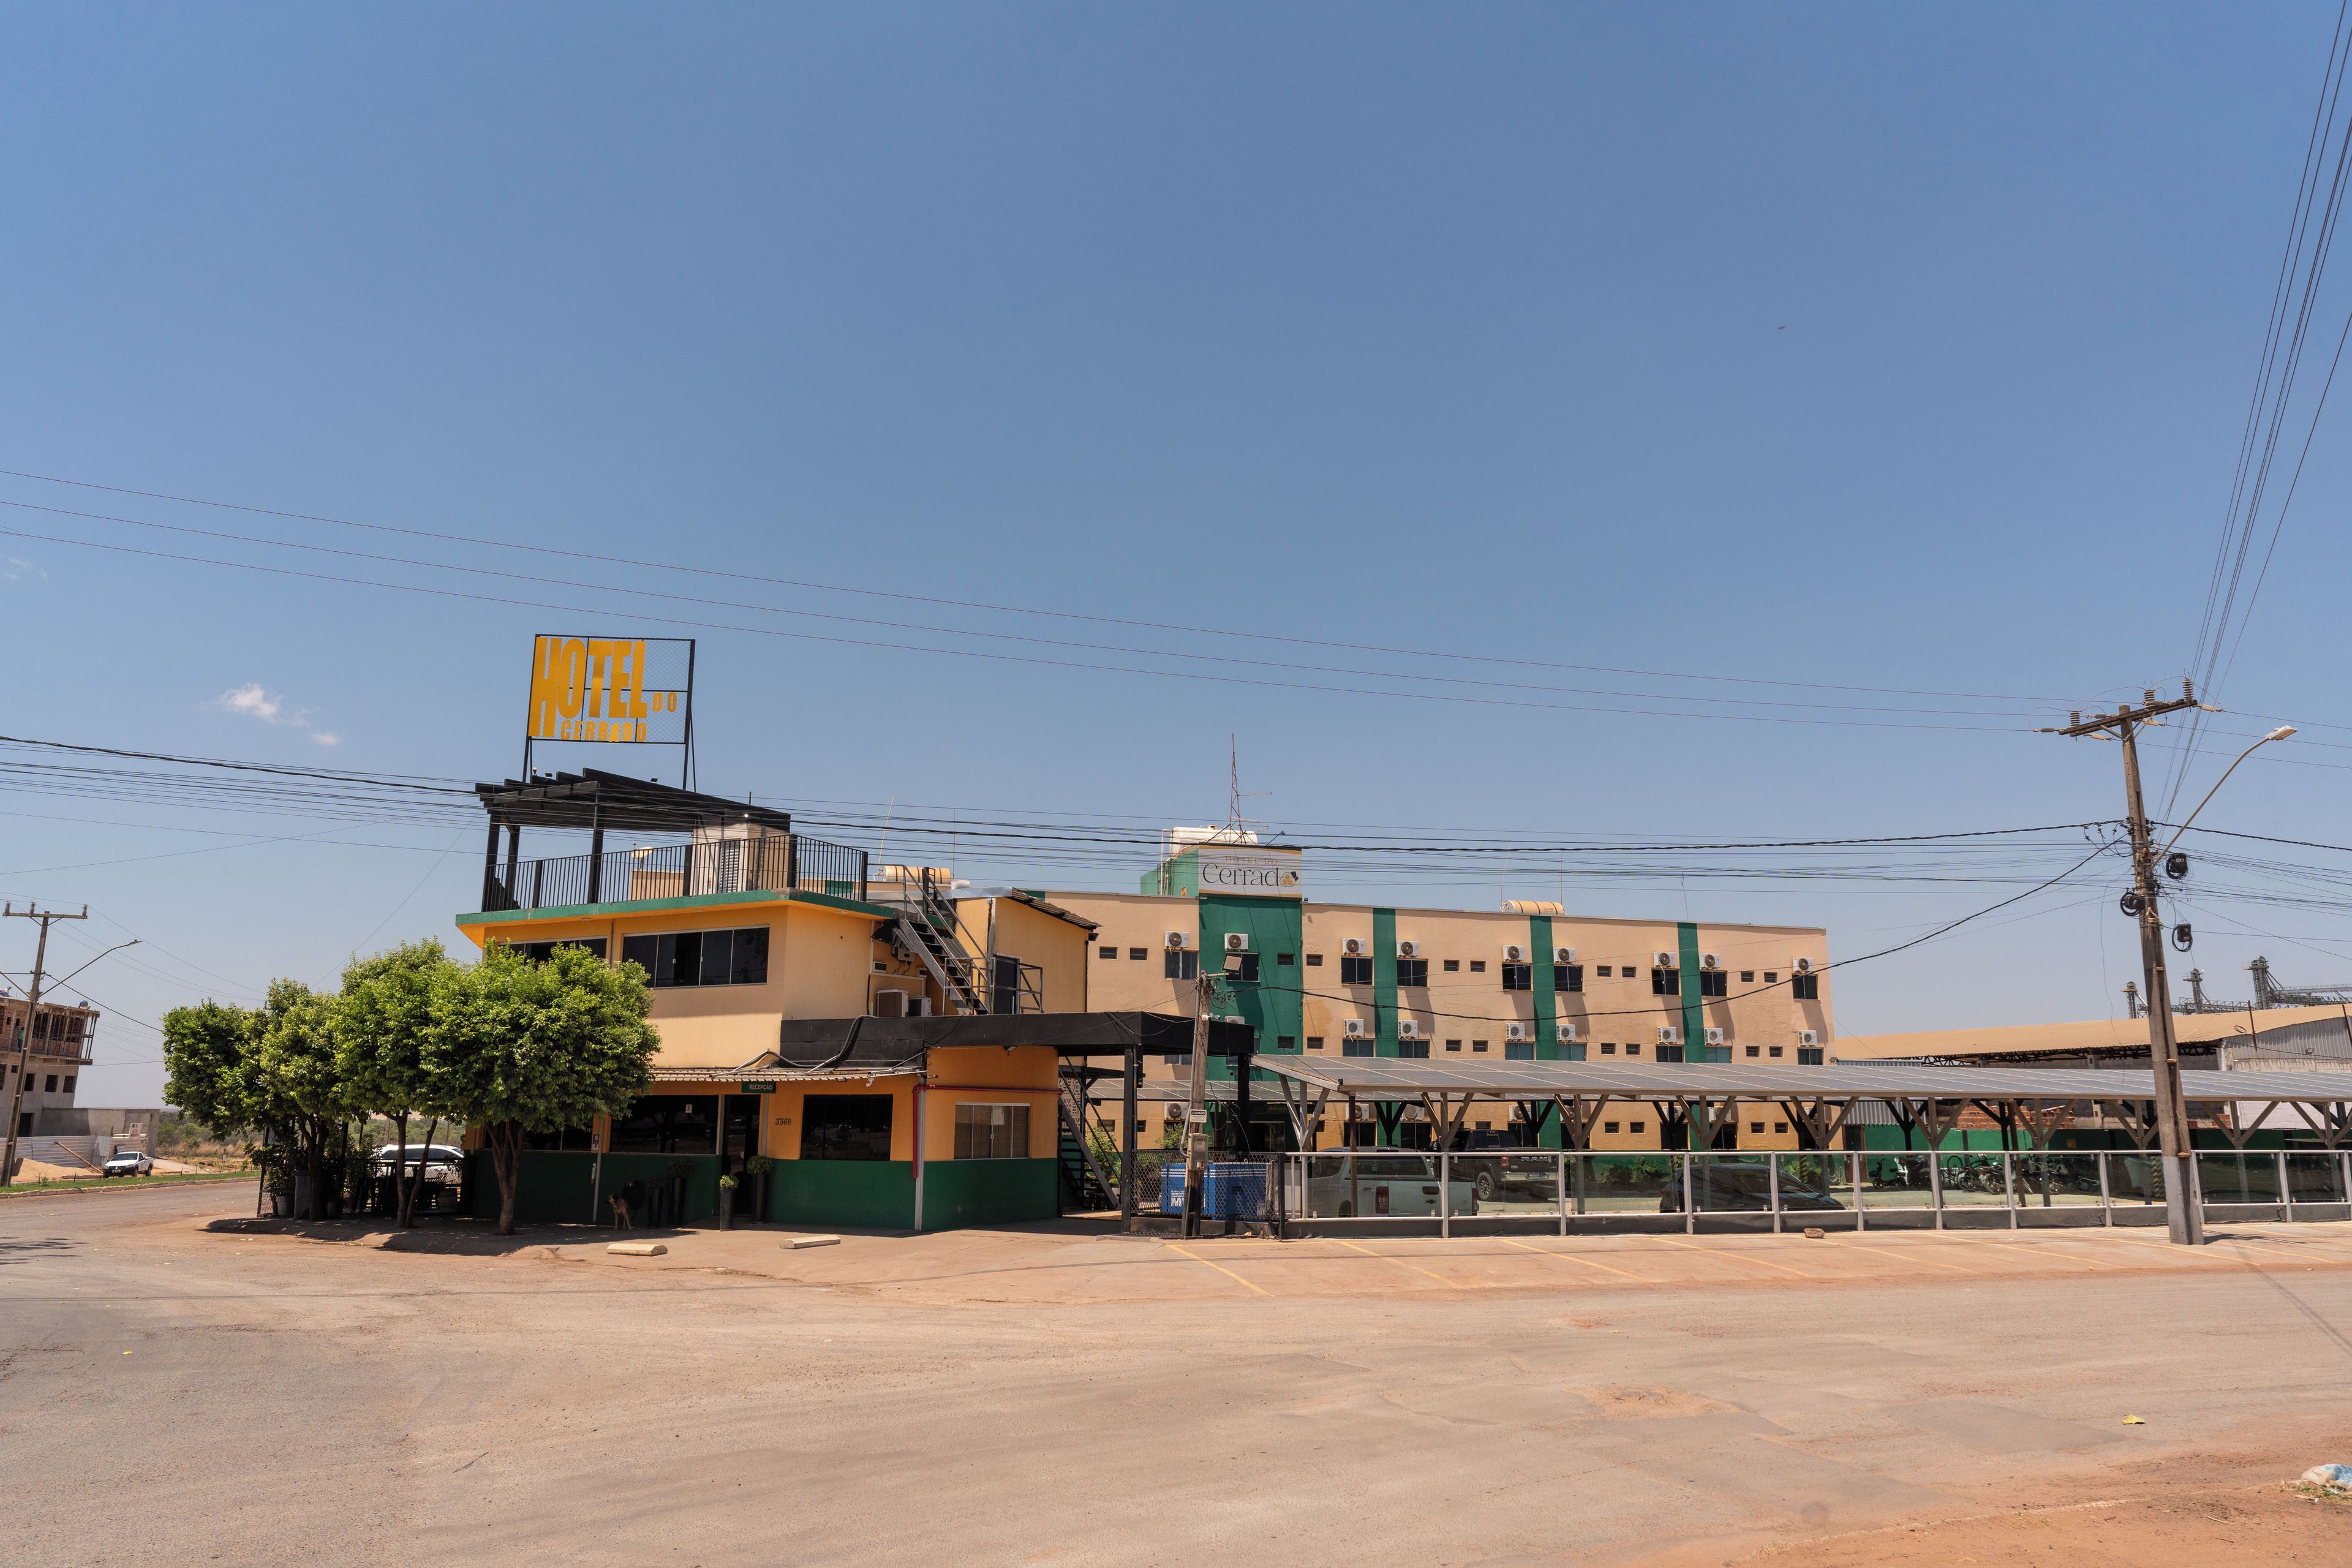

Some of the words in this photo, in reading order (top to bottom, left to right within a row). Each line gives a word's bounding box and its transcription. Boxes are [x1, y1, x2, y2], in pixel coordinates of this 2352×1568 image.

[528, 637, 647, 737] HOTEL
[652, 692, 677, 712] DO
[560, 720, 647, 743] CERRADO
[1225, 856, 1259, 864] HOTEL
[775, 1117, 792, 1126] 3360
